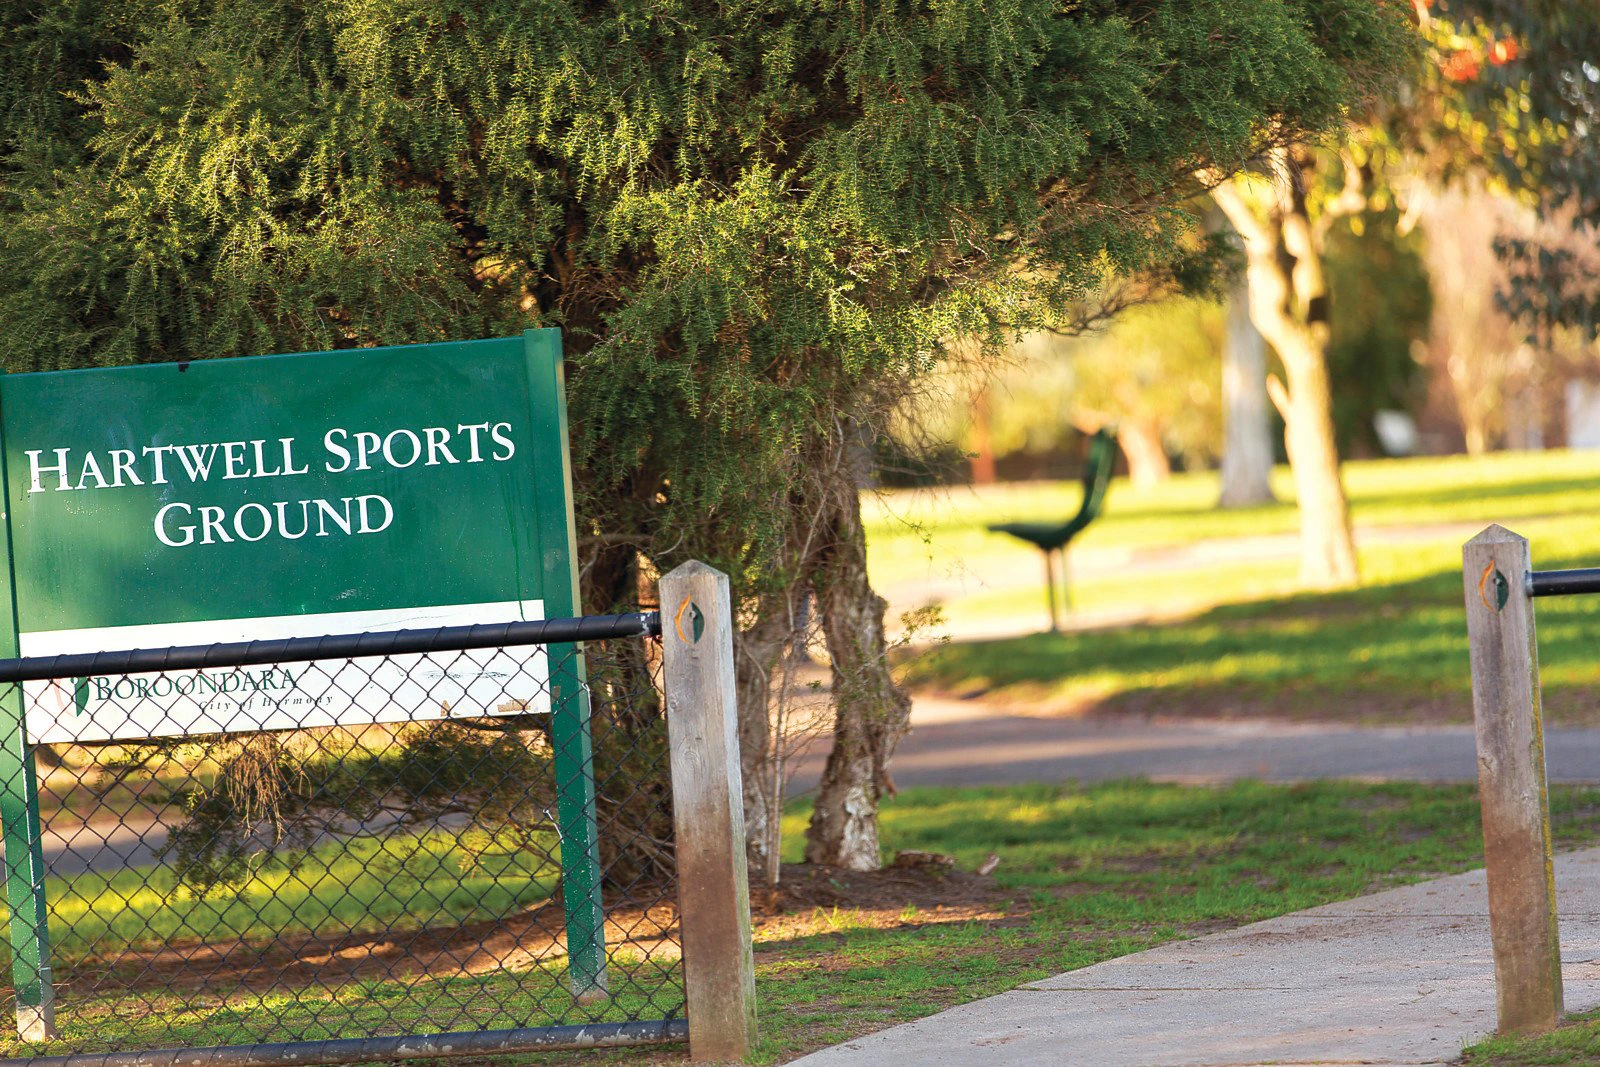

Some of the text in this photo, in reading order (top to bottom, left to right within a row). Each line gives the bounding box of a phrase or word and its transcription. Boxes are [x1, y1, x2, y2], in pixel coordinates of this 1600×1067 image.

[25, 421, 515, 494] HARTWELL SPORTS
[153, 494, 394, 547] GROUND
[95, 669, 297, 700] BOROONDARA
[199, 700, 231, 713] City
